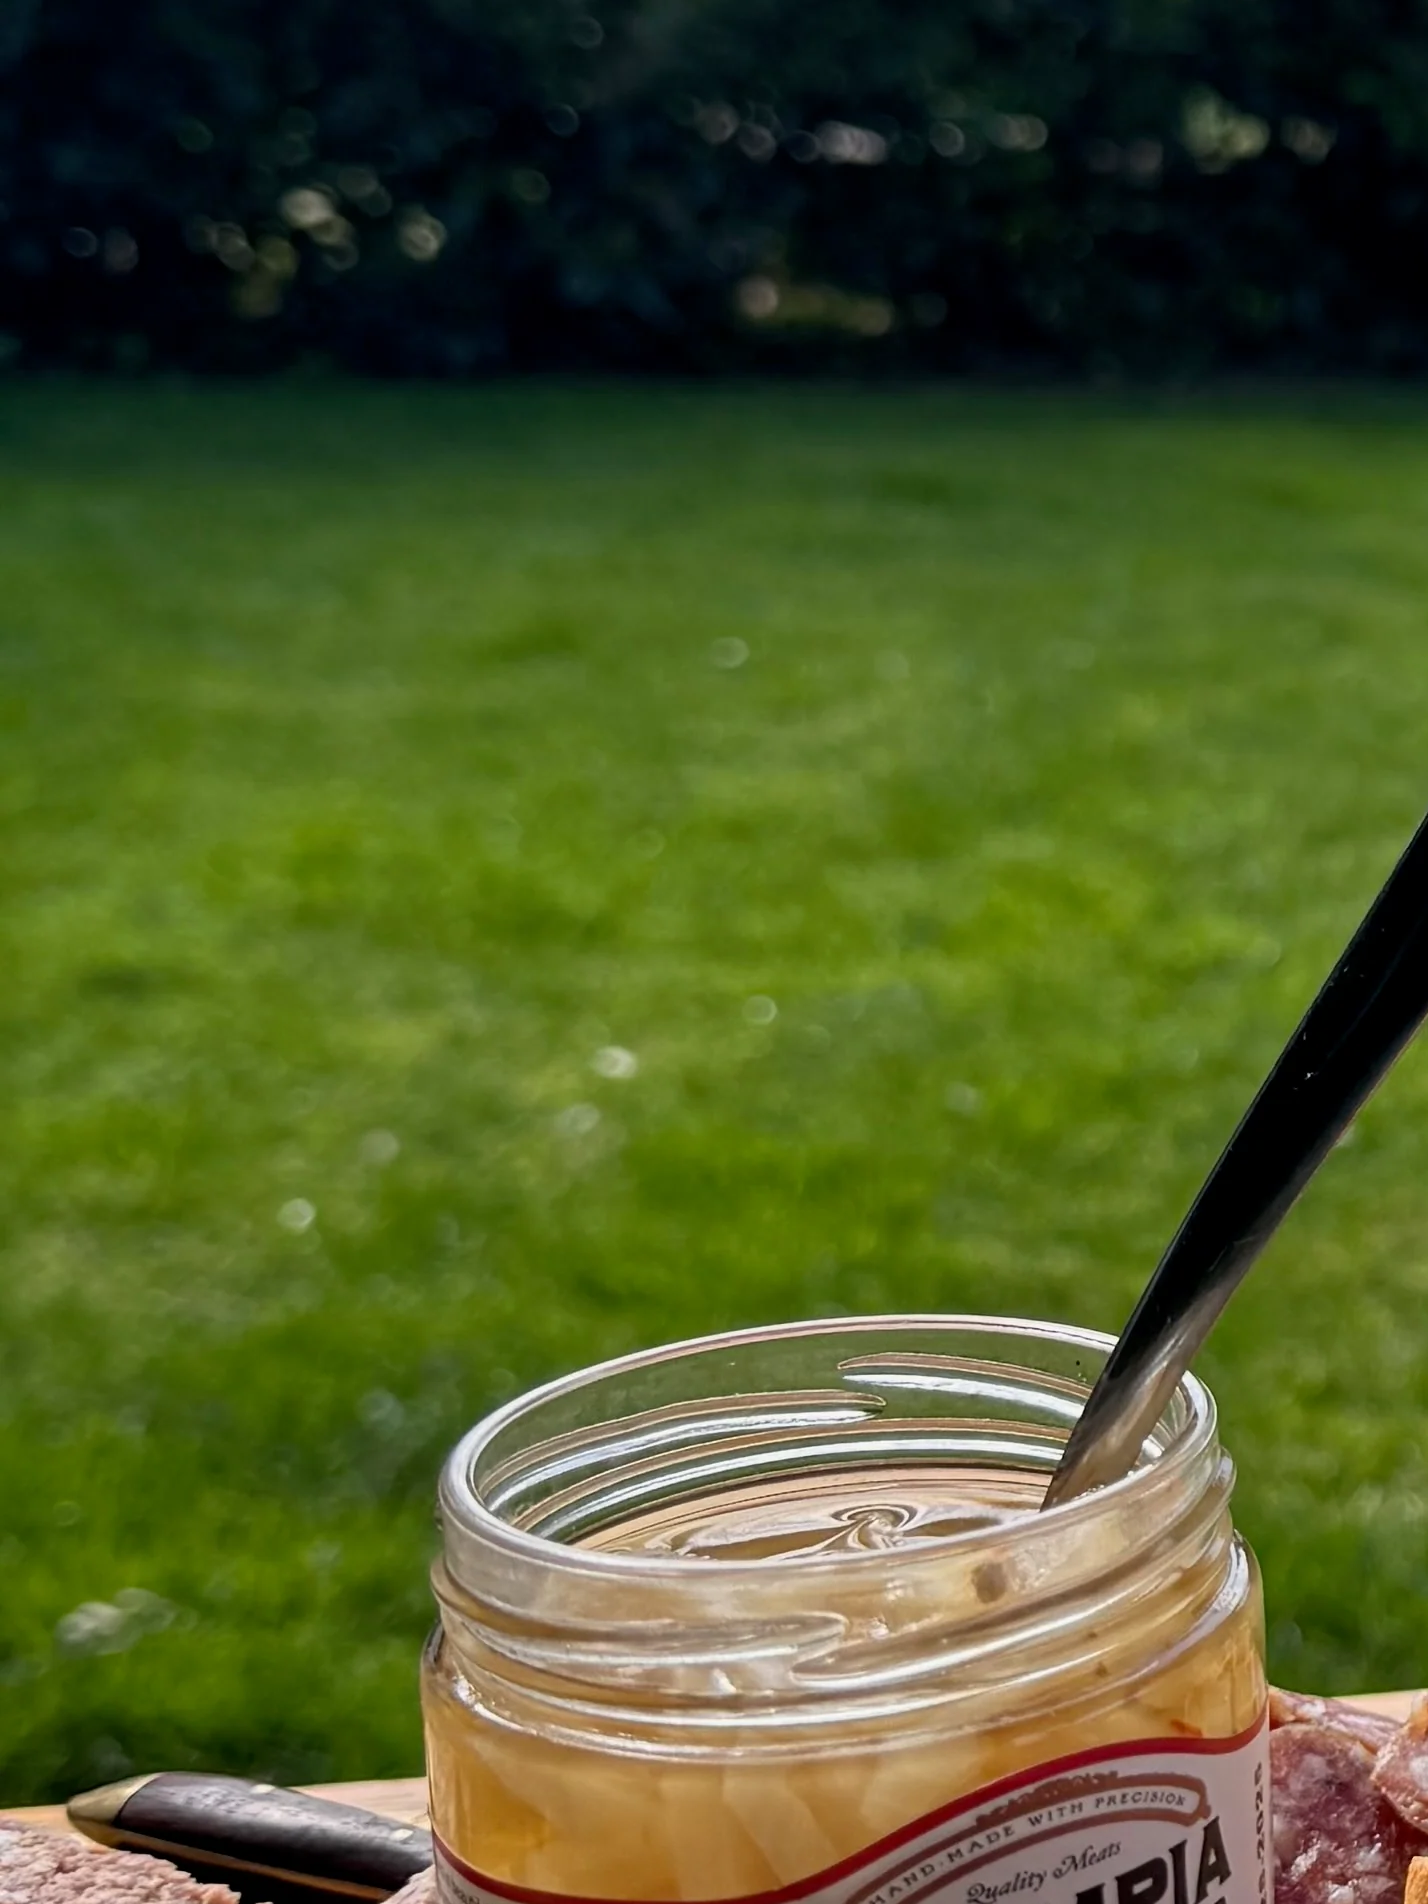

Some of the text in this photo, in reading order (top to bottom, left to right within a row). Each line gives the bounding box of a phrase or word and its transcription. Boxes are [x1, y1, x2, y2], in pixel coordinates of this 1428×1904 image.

[1027, 1801, 1084, 1828] WITH
[1095, 1790, 1187, 1810] PRECISION
[1052, 1841, 1122, 1879] Meats
